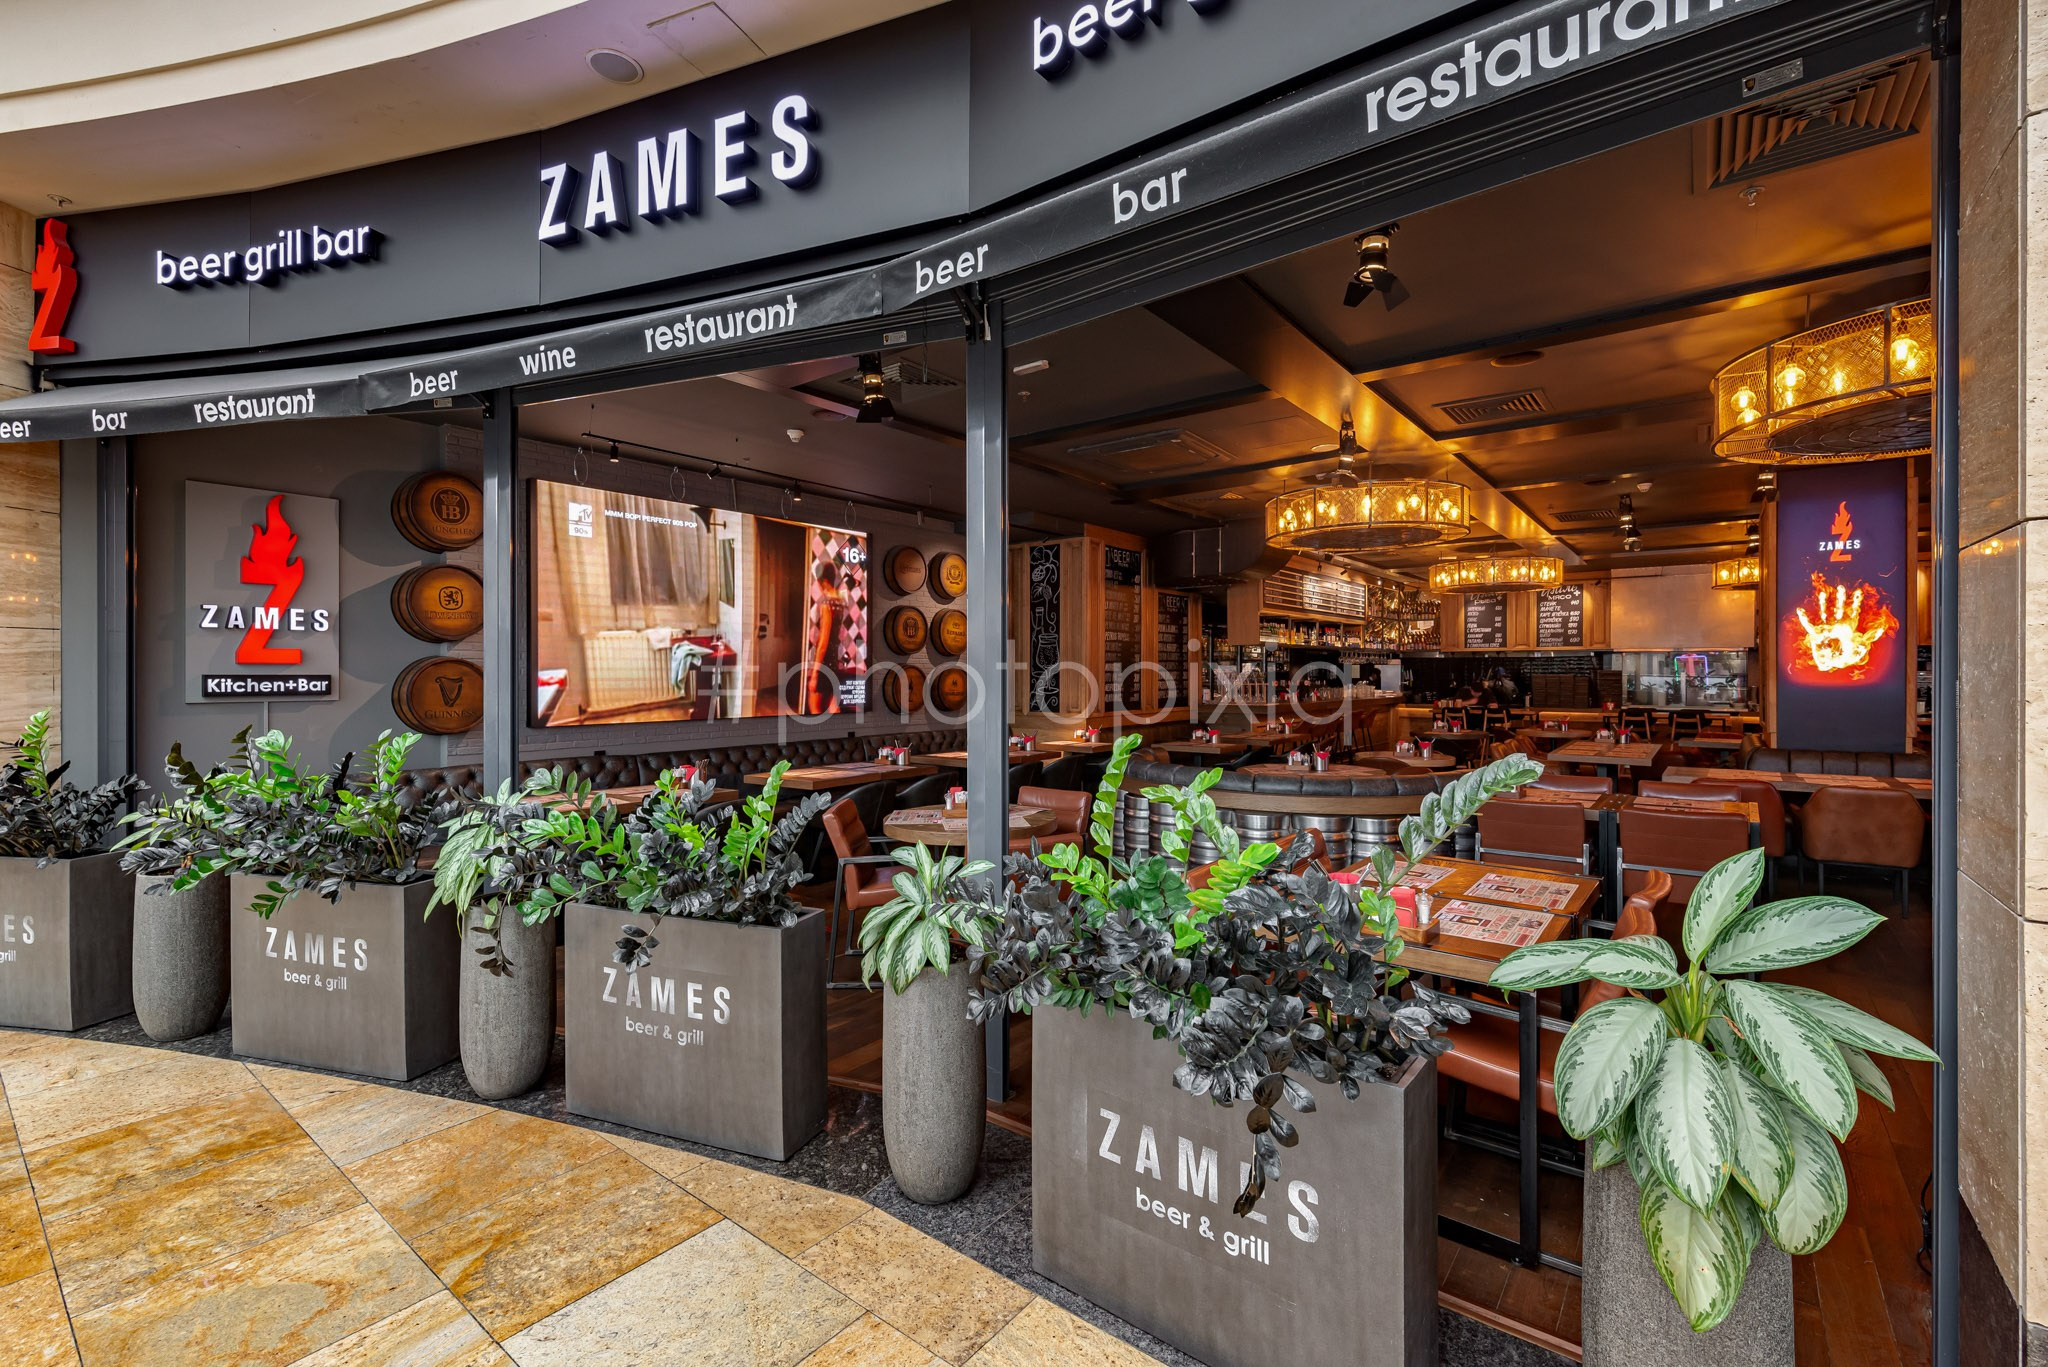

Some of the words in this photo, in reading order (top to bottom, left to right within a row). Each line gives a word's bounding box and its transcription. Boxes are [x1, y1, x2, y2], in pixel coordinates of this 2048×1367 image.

[1034, 0, 1155, 70] bee
[1366, 0, 1741, 134] restaura
[539, 95, 808, 242] ZAMES
[915, 241, 989, 294] beer
[1112, 166, 1187, 225] bar
[156, 249, 236, 284] beer
[244, 230, 302, 282] grill
[313, 225, 370, 261] bar
[409, 368, 458, 398] beer
[519, 344, 576, 376] wine
[644, 295, 798, 353] restaurant
[92, 406, 128, 432] bar
[194, 389, 317, 424] restaurant
[642, 514, 672, 525] PERFECT
[684, 521, 698, 529] POP
[842, 546, 867, 565] 16+
[1819, 540, 1861, 552] ZAMES
[200, 604, 329, 632] ZAMES
[207, 678, 329, 693] Kitchen+Bar
[265, 926, 368, 972] ZAMES
[284, 968, 311, 985] beer
[314, 974, 323, 987] &
[326, 976, 347, 991] grill
[602, 966, 731, 1025] ZAMES
[625, 1016, 659, 1037] beer
[662, 1025, 673, 1040] &
[677, 1029, 704, 1047] grill
[1136, 1187, 1191, 1229] beer
[1199, 1216, 1215, 1241] &
[1223, 1231, 1270, 1265] grill
